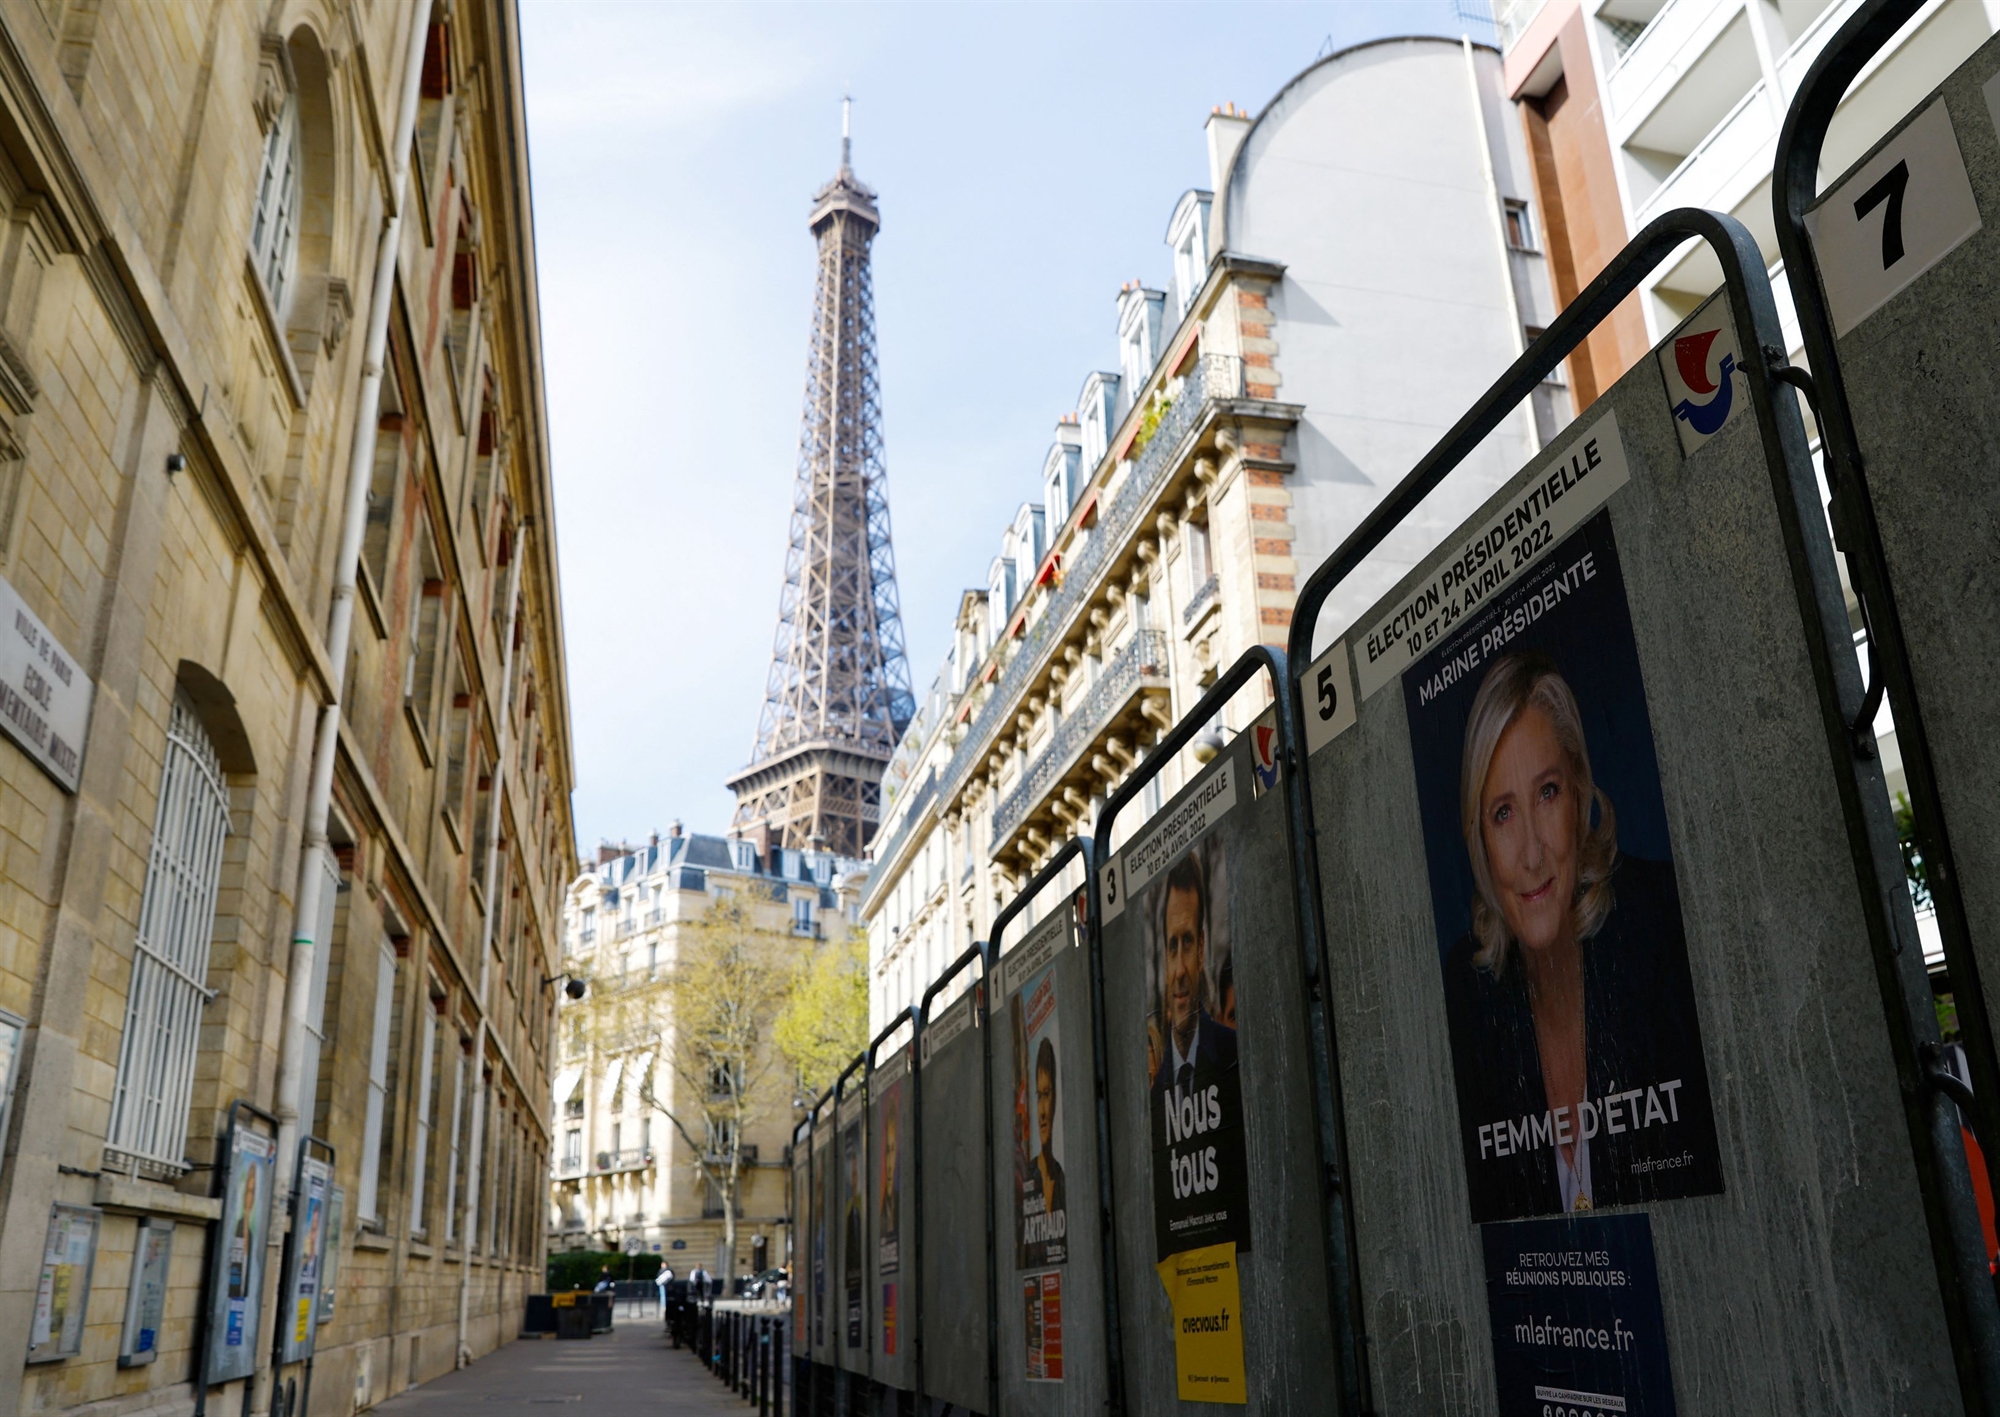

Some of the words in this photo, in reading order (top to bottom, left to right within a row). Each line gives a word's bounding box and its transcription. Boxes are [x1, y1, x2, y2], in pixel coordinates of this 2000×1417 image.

[1853, 158, 1910, 271] 7
[1366, 582, 1440, 664] ÉLECTION
[1441, 437, 1602, 598] PRÉSIDENTIELLE
[1406, 630, 1422, 657] 10
[1424, 618, 1440, 643] ET
[1441, 605, 1461, 630] 24
[1464, 563, 1511, 612] AVRIL
[1511, 519, 1554, 570] 2022
[1526, 574, 1542, 590] AVRIL
[15, 608, 38, 649] VILLE
[39, 634, 51, 663] DE
[51, 649, 73, 688] PARIS
[1419, 643, 1480, 706] MARINE
[1481, 551, 1597, 658] PRÉSIDENTE
[1317, 664, 1337, 721] 5
[1130, 836, 1162, 875] ÉLECTION
[1163, 771, 1228, 844] PRÉSIDENTIELLE
[1147, 864, 1154, 878] 10
[1154, 859, 1162, 871] ET
[1162, 850, 1170, 865] 24
[1170, 834, 1190, 855] AVRIL
[1190, 813, 1206, 839] 2022
[1107, 868, 1116, 905] 3
[994, 971, 998, 999] 1
[1164, 1084, 1221, 1146] Nous
[1478, 1106, 1573, 1160] FEMME
[1577, 1079, 1682, 1141] D'ÉTAT
[1170, 1145, 1219, 1200] tous
[1631, 1150, 1694, 1174] mlafrance.fr
[1023, 1209, 1066, 1245] ARTHAUD
[1204, 1213, 1215, 1223] avec
[1215, 1210, 1228, 1221] vous
[1506, 1267, 1560, 1286] RÉUNIONS
[1561, 1270, 1626, 1287] PUBLIQUES
[1519, 1252, 1584, 1267] RETROUVEZ
[1585, 1251, 1610, 1266] MES
[1182, 1307, 1230, 1334] avecvous.fr
[1515, 1315, 1634, 1352] mlafrance.fr
[1536, 1389, 1552, 1398] SUIVRE
[1552, 1391, 1558, 1399] LA
[1558, 1392, 1582, 1402] CAMPAGNE
